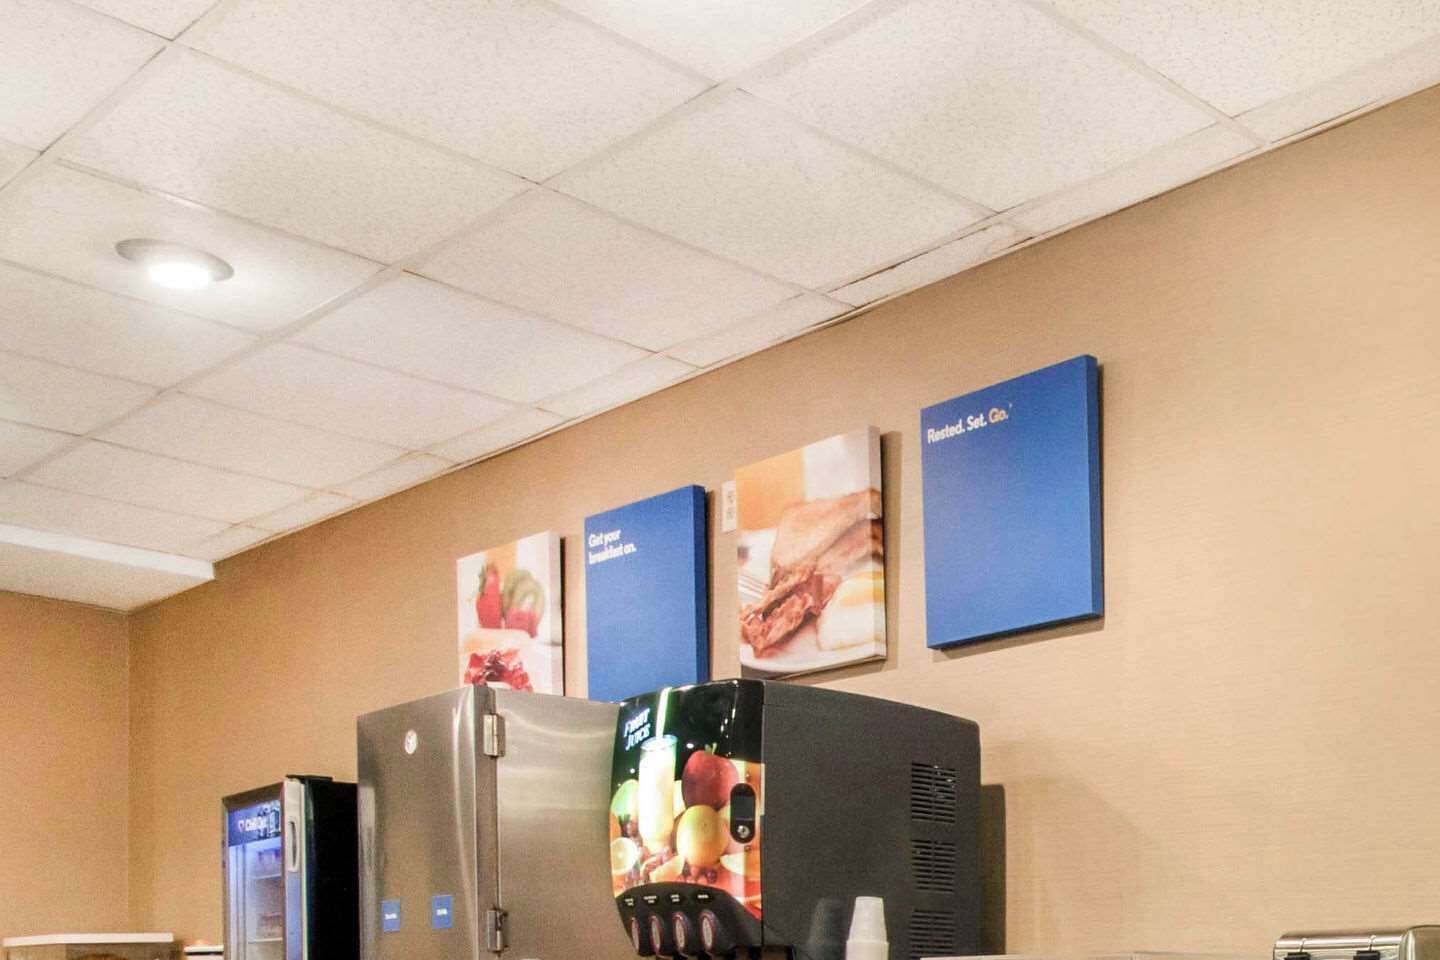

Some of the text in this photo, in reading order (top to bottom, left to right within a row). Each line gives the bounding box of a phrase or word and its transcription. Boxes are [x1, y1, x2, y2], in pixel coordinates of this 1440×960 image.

[927, 406, 1009, 445] Rested. Set. Go.
[588, 529, 621, 553] Get your
[625, 722, 651, 751] JUICE
